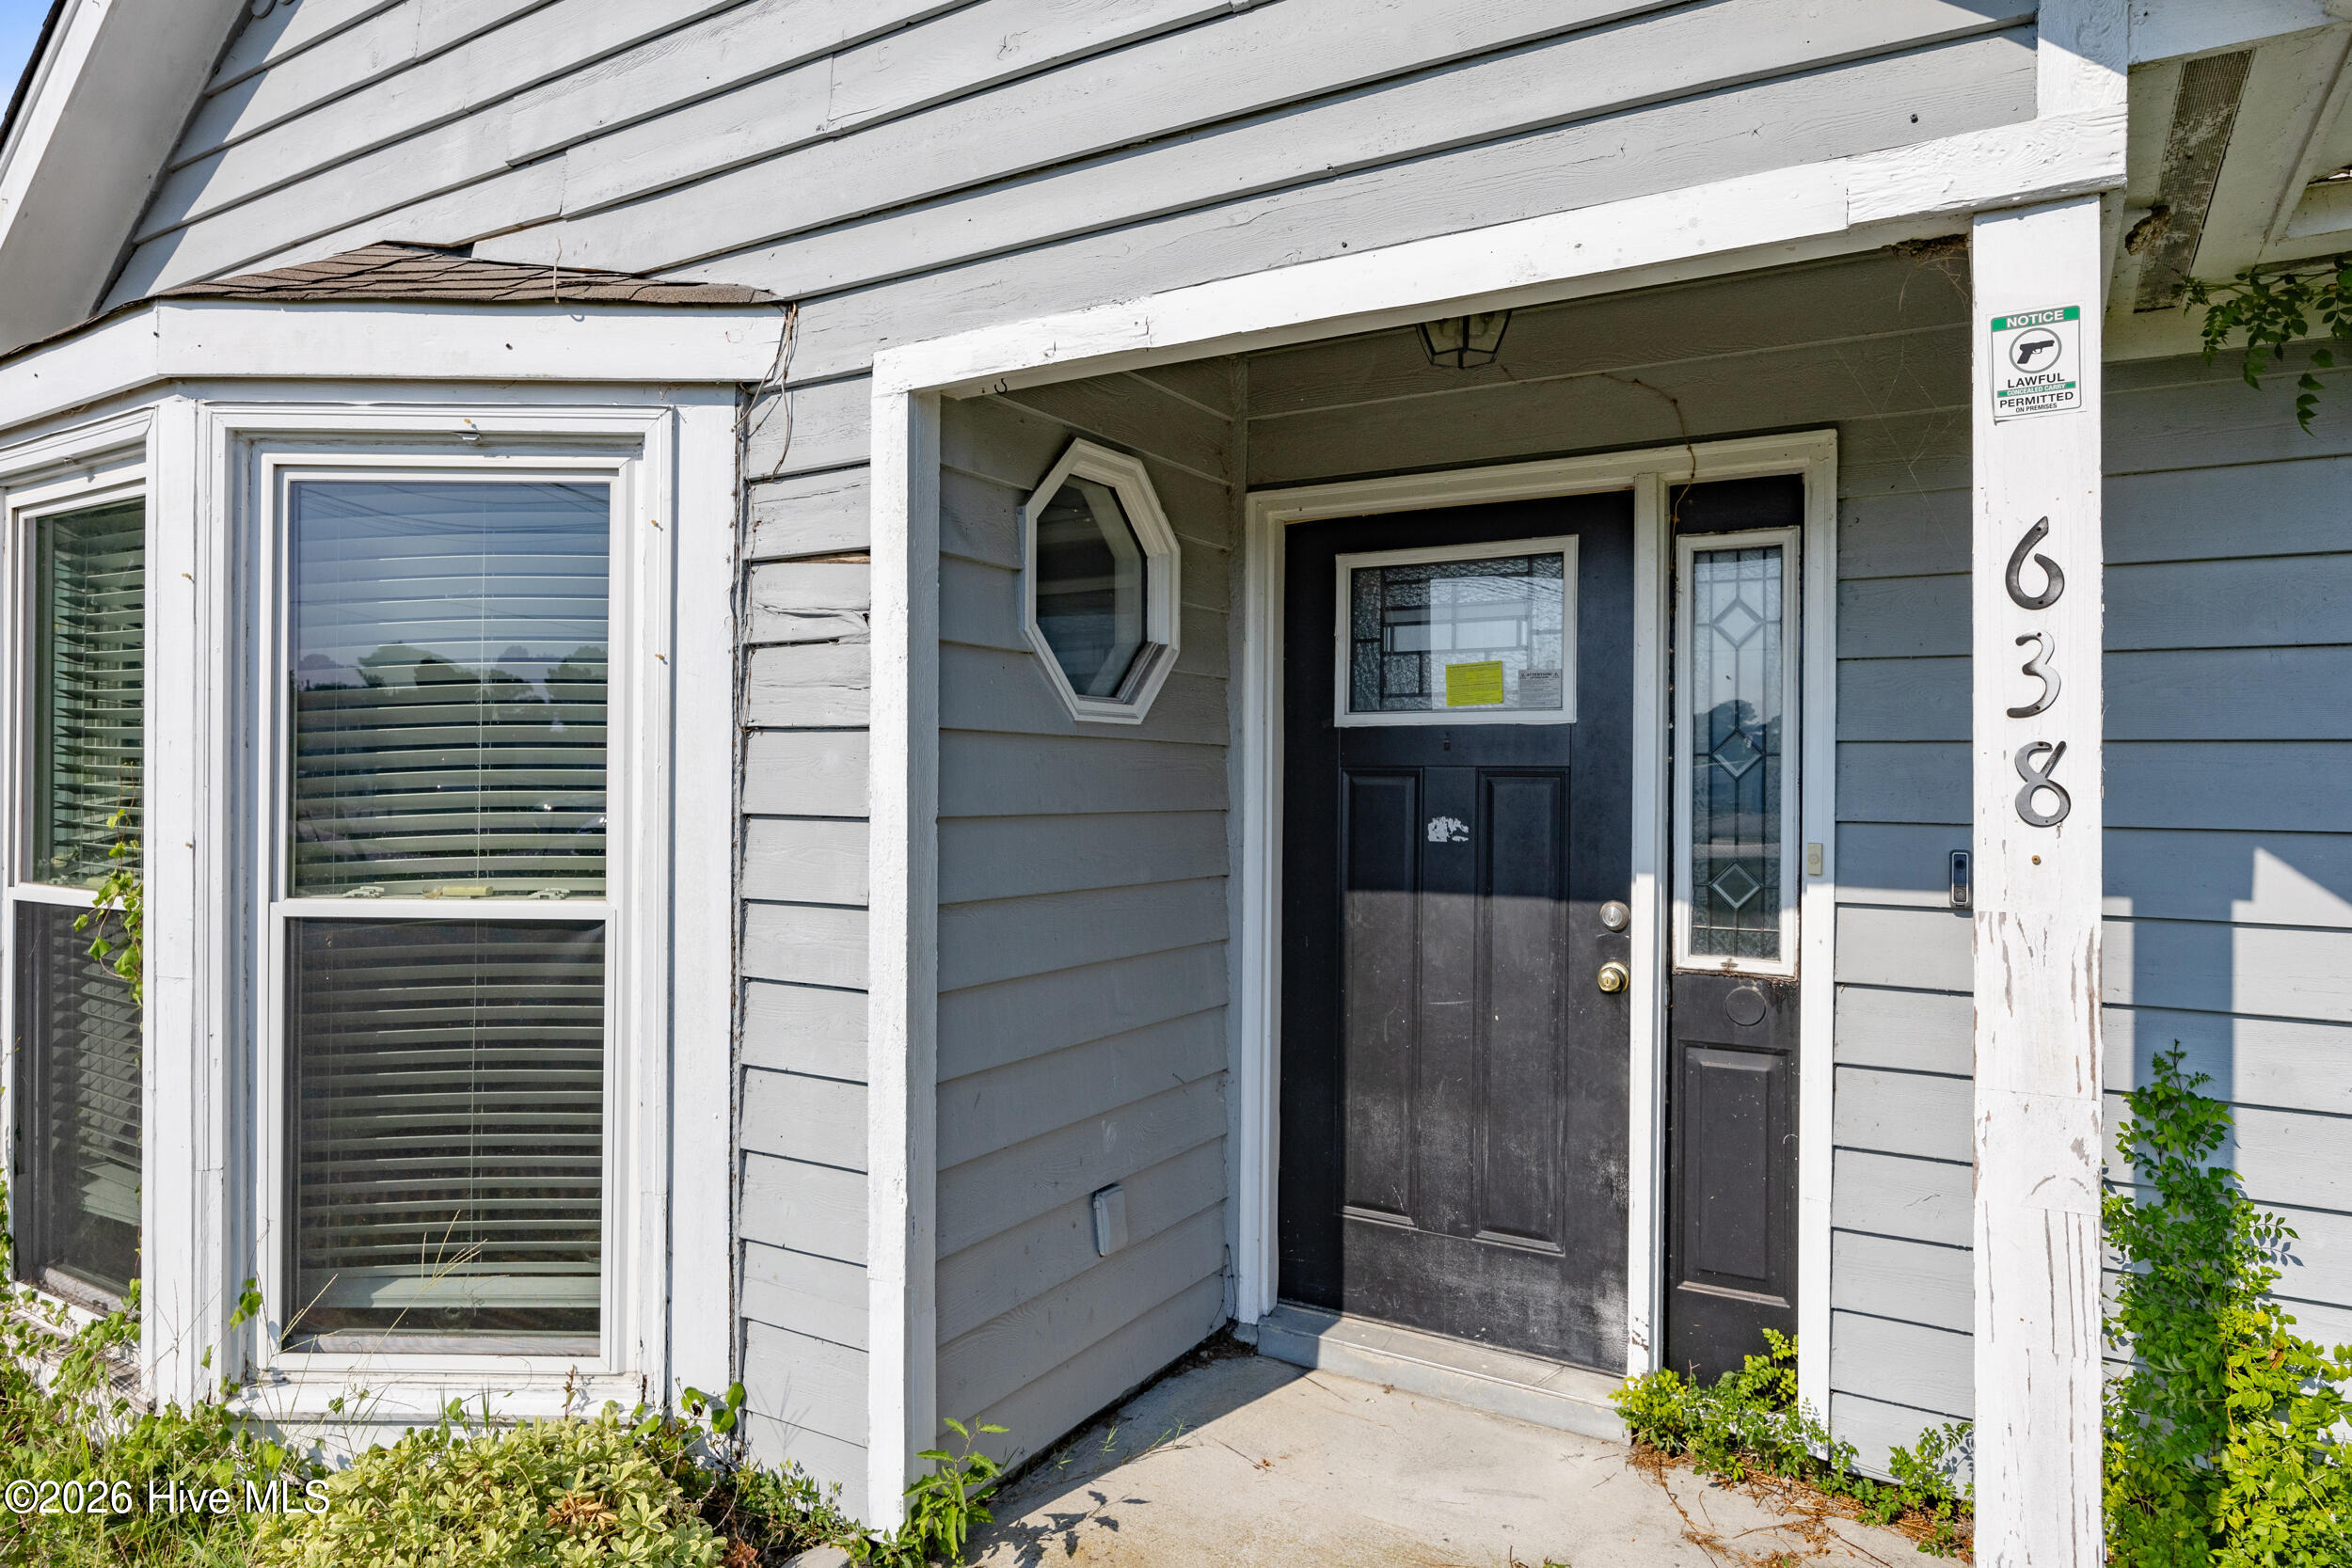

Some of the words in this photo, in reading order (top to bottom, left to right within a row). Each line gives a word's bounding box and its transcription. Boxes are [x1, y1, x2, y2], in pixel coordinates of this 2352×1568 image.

[2007, 309, 2064, 327] NOTICE
[2008, 372, 2065, 388] LAWFUL
[2007, 386, 2043, 396] CONCEALED
[2044, 383, 2066, 391] CARRY
[1999, 391, 2074, 408] PERMITTED
[2026, 403, 2058, 412] PREMISES
